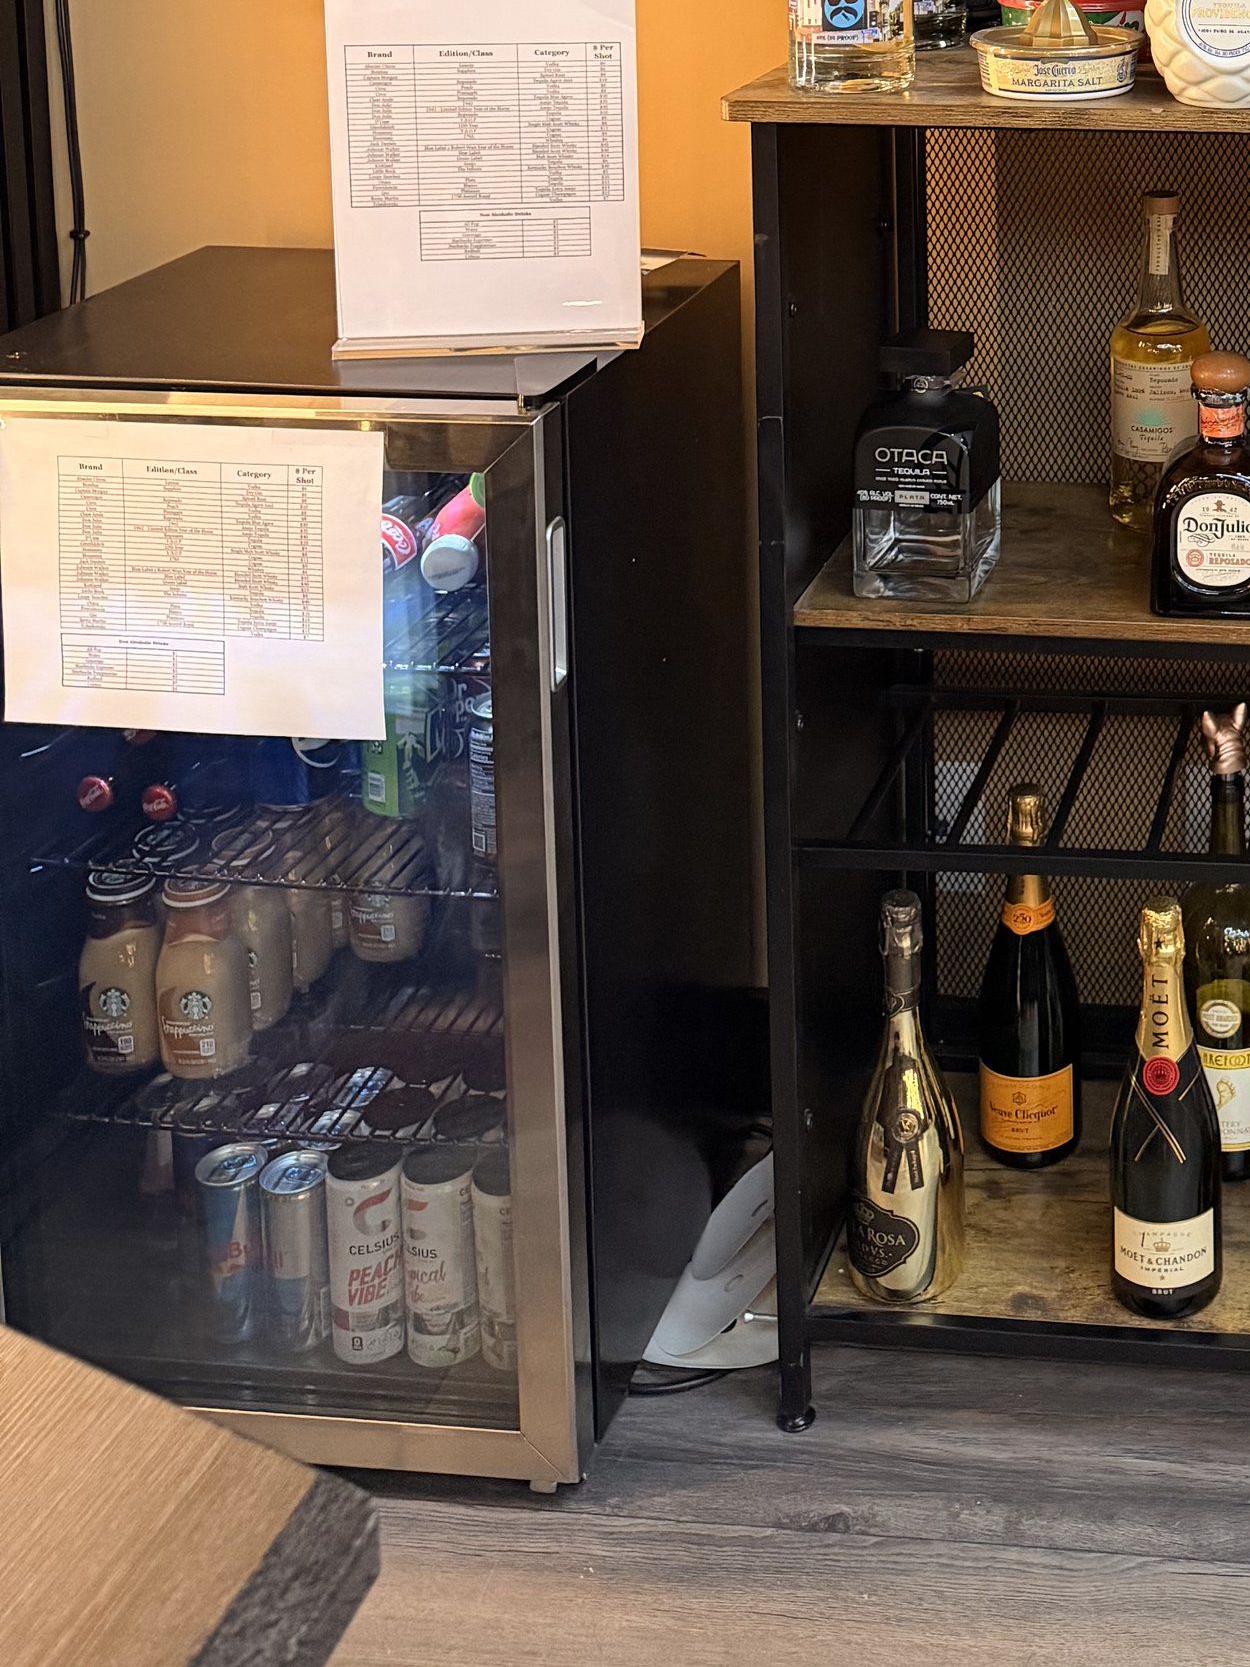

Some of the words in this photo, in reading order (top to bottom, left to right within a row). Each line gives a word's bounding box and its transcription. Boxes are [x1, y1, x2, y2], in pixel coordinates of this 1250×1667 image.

[366, 50, 393, 59] Brand
[438, 49, 494, 59] Edition/Class
[533, 48, 571, 59] Category
[600, 43, 615, 52] Per
[593, 51, 613, 60] Shot
[1011, 76, 1076, 89] MARGARITA
[1077, 75, 1104, 88] SALT
[1130, 424, 1174, 435] CASAMIGOS
[1138, 433, 1165, 443] Tequila
[874, 446, 948, 466] OTACA
[78, 462, 104, 471] Brand
[145, 465, 198, 476] Edition/Class
[236, 469, 273, 480] Category
[301, 467, 317, 476] Per
[892, 466, 931, 476] TEQUILA
[295, 476, 315, 485] Shot
[1147, 972, 1170, 1051] MOËT
[989, 1099, 1014, 1120] Veuve
[1014, 1103, 1059, 1122] Clicquot
[1011, 1126, 1030, 1135] BRUT
[348, 1232, 401, 1256] CELSIUS
[1154, 1246, 1208, 1267] CHANDON
[347, 1279, 388, 1307] VIBE
[1151, 1287, 1174, 1296] BRUT
